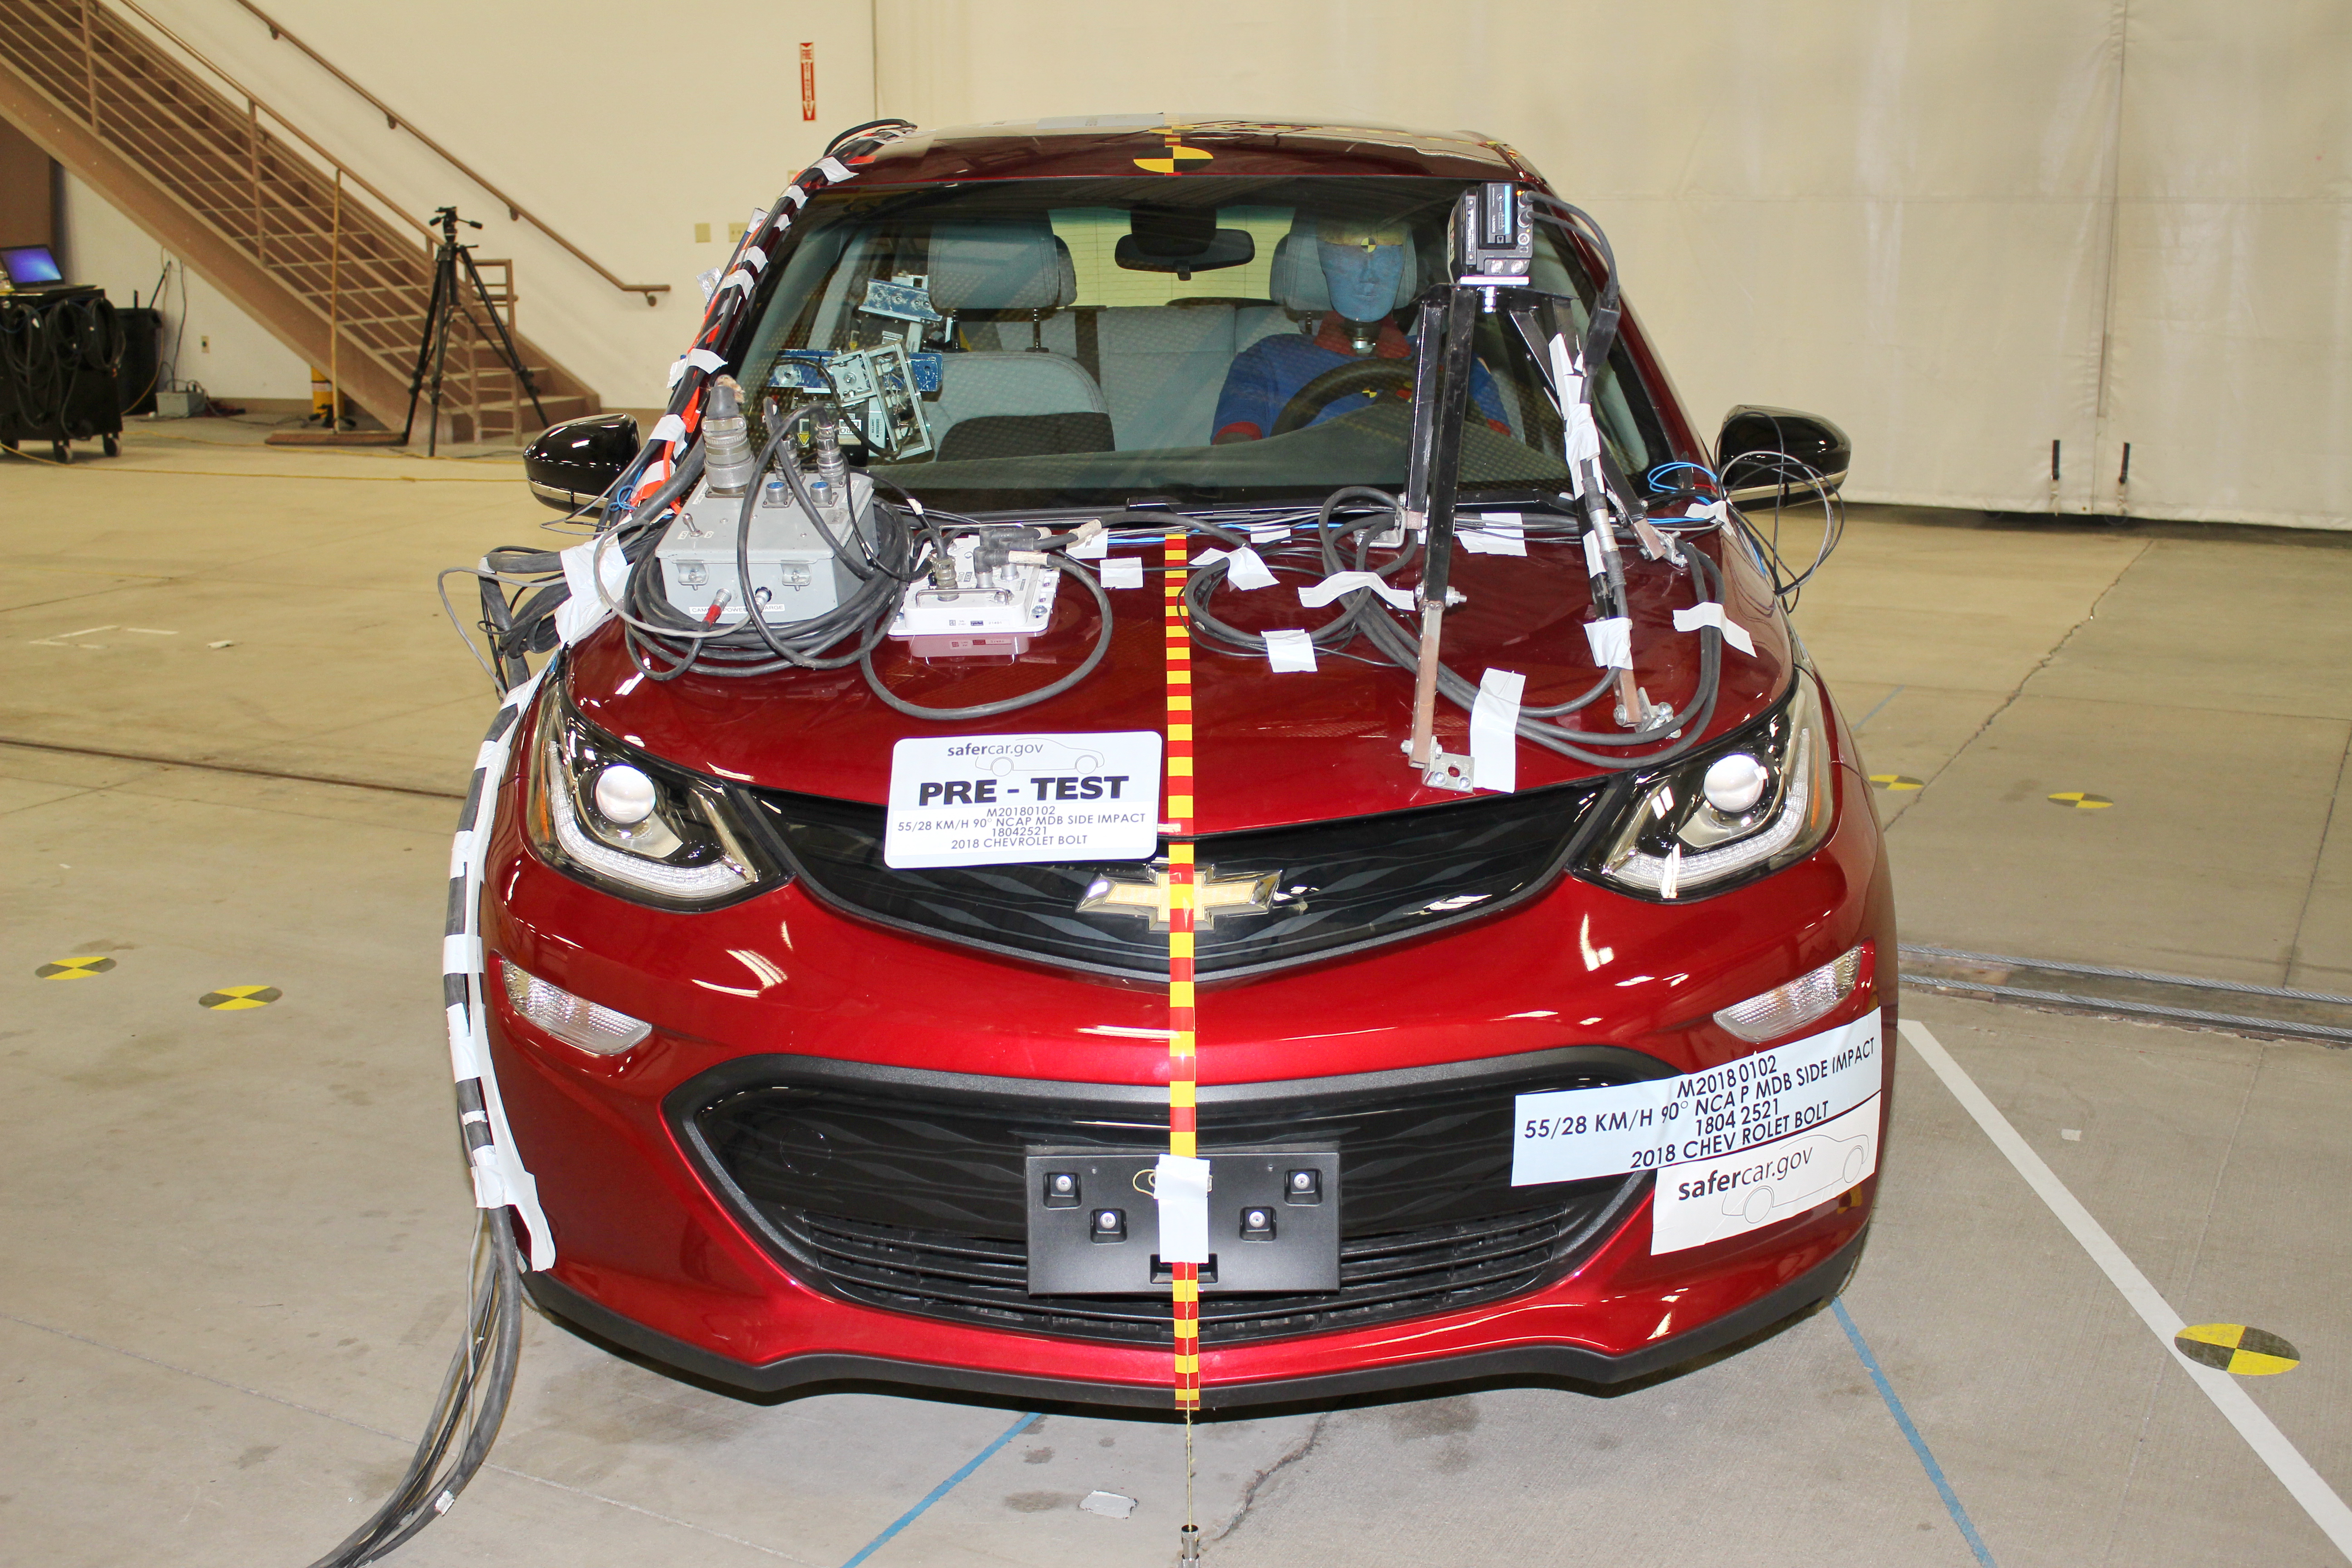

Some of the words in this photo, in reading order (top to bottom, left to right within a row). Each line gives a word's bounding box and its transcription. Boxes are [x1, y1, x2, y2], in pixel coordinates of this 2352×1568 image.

[947, 742, 1044, 757] safercar.gov
[919, 779, 997, 806] PRE
[1031, 776, 1129, 801] TEST
[987, 806, 1056, 817] M20180102
[898, 821, 932, 832] 55/28
[936, 819, 969, 830] KM/H
[996, 817, 1032, 827] NCAP
[1036, 816, 1063, 825] MDB
[1068, 815, 1094, 824] SIDE
[1098, 813, 1146, 823] IMPACT
[992, 826, 1047, 838] 18042521
[951, 839, 980, 849] 2018
[984, 836, 1054, 848] CHEVROLET
[1058, 835, 1088, 845] BOLT
[1524, 1116, 1587, 1139] 55/28
[1595, 1108, 1653, 1132] KM/H
[1756, 1073, 1792, 1099] MDB
[1796, 1059, 1828, 1087] SIDE
[1832, 1037, 1874, 1074] IMPACT
[1630, 1144, 1676, 1169] 2018
[1795, 1100, 1828, 1128] BOLT
[1678, 1147, 1813, 1200] safercar.gov
